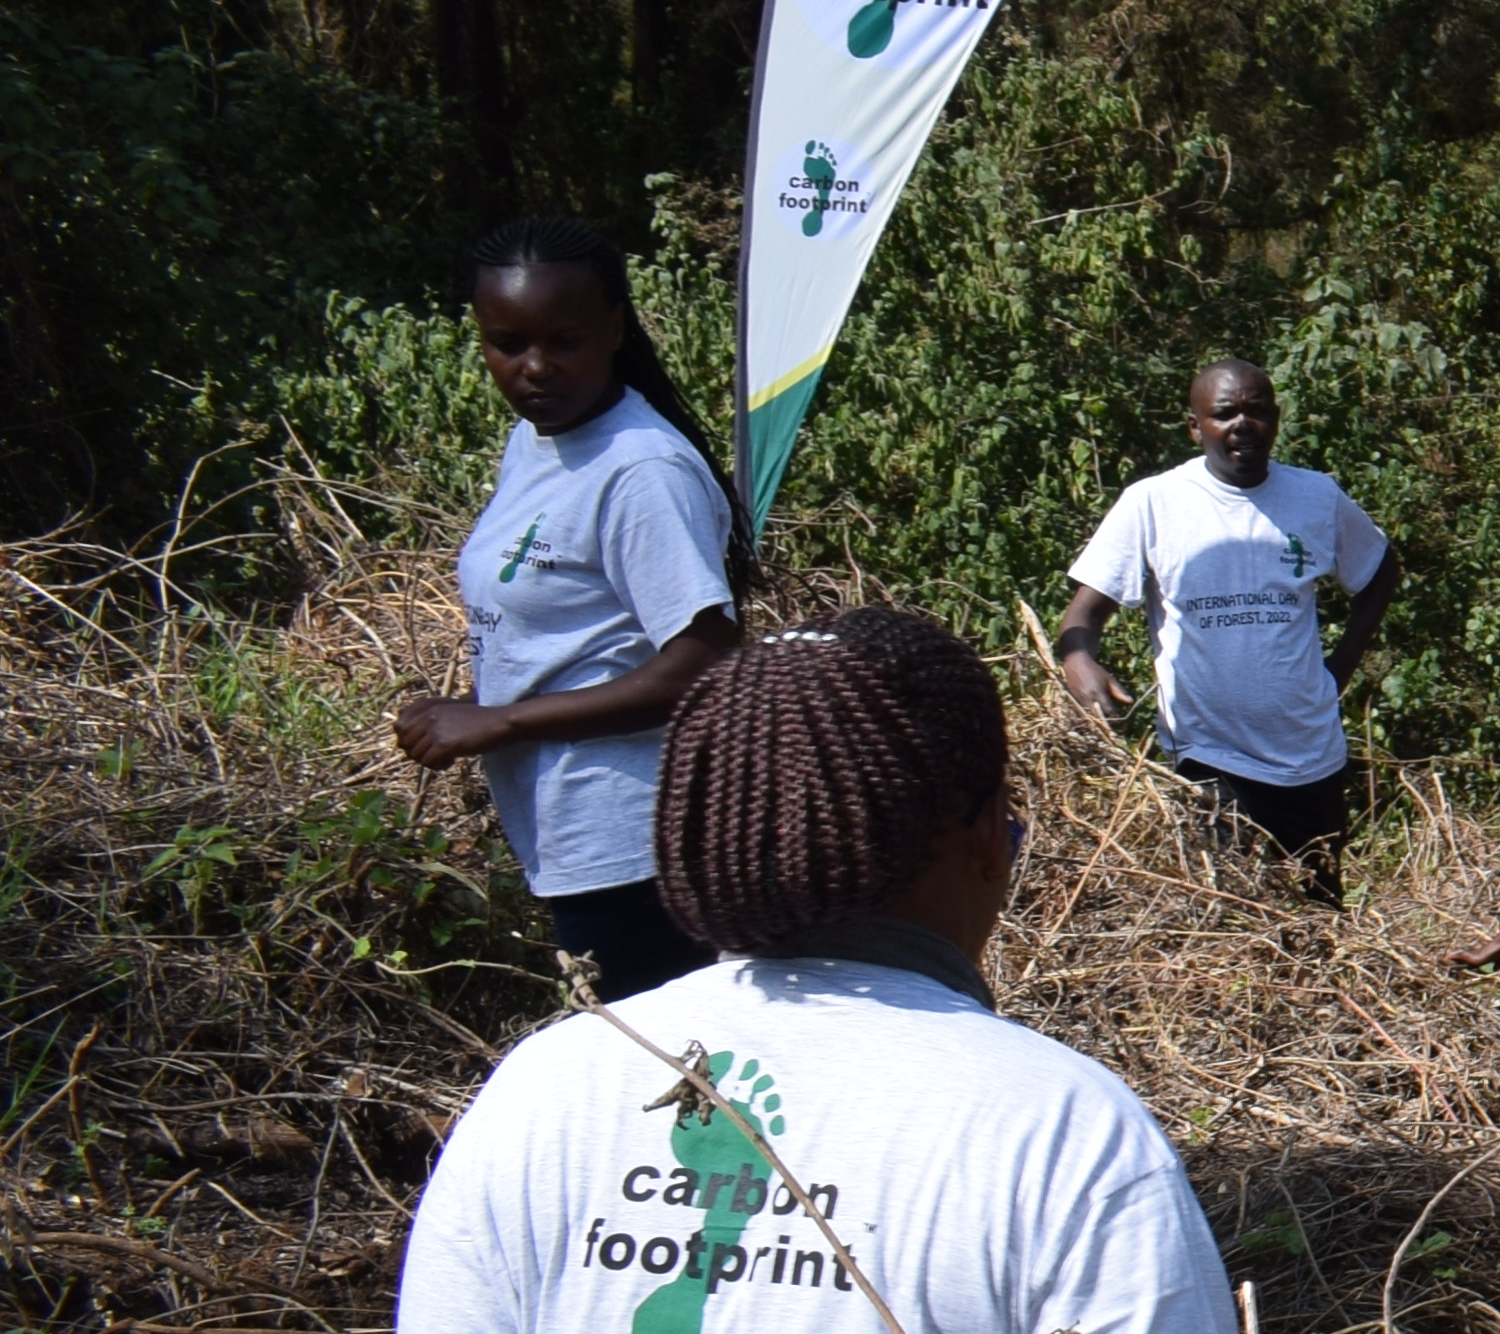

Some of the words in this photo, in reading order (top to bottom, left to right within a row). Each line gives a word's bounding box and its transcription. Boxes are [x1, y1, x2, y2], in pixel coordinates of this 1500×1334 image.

[789, 175, 859, 192] carbon
[779, 193, 867, 216] footprint
[1186, 593, 1277, 612] INTERNATIONAL
[1200, 616, 1213, 628] OF
[1266, 611, 1292, 623] 2022
[622, 1163, 839, 1220] carbon
[583, 1217, 858, 1295] footprint
